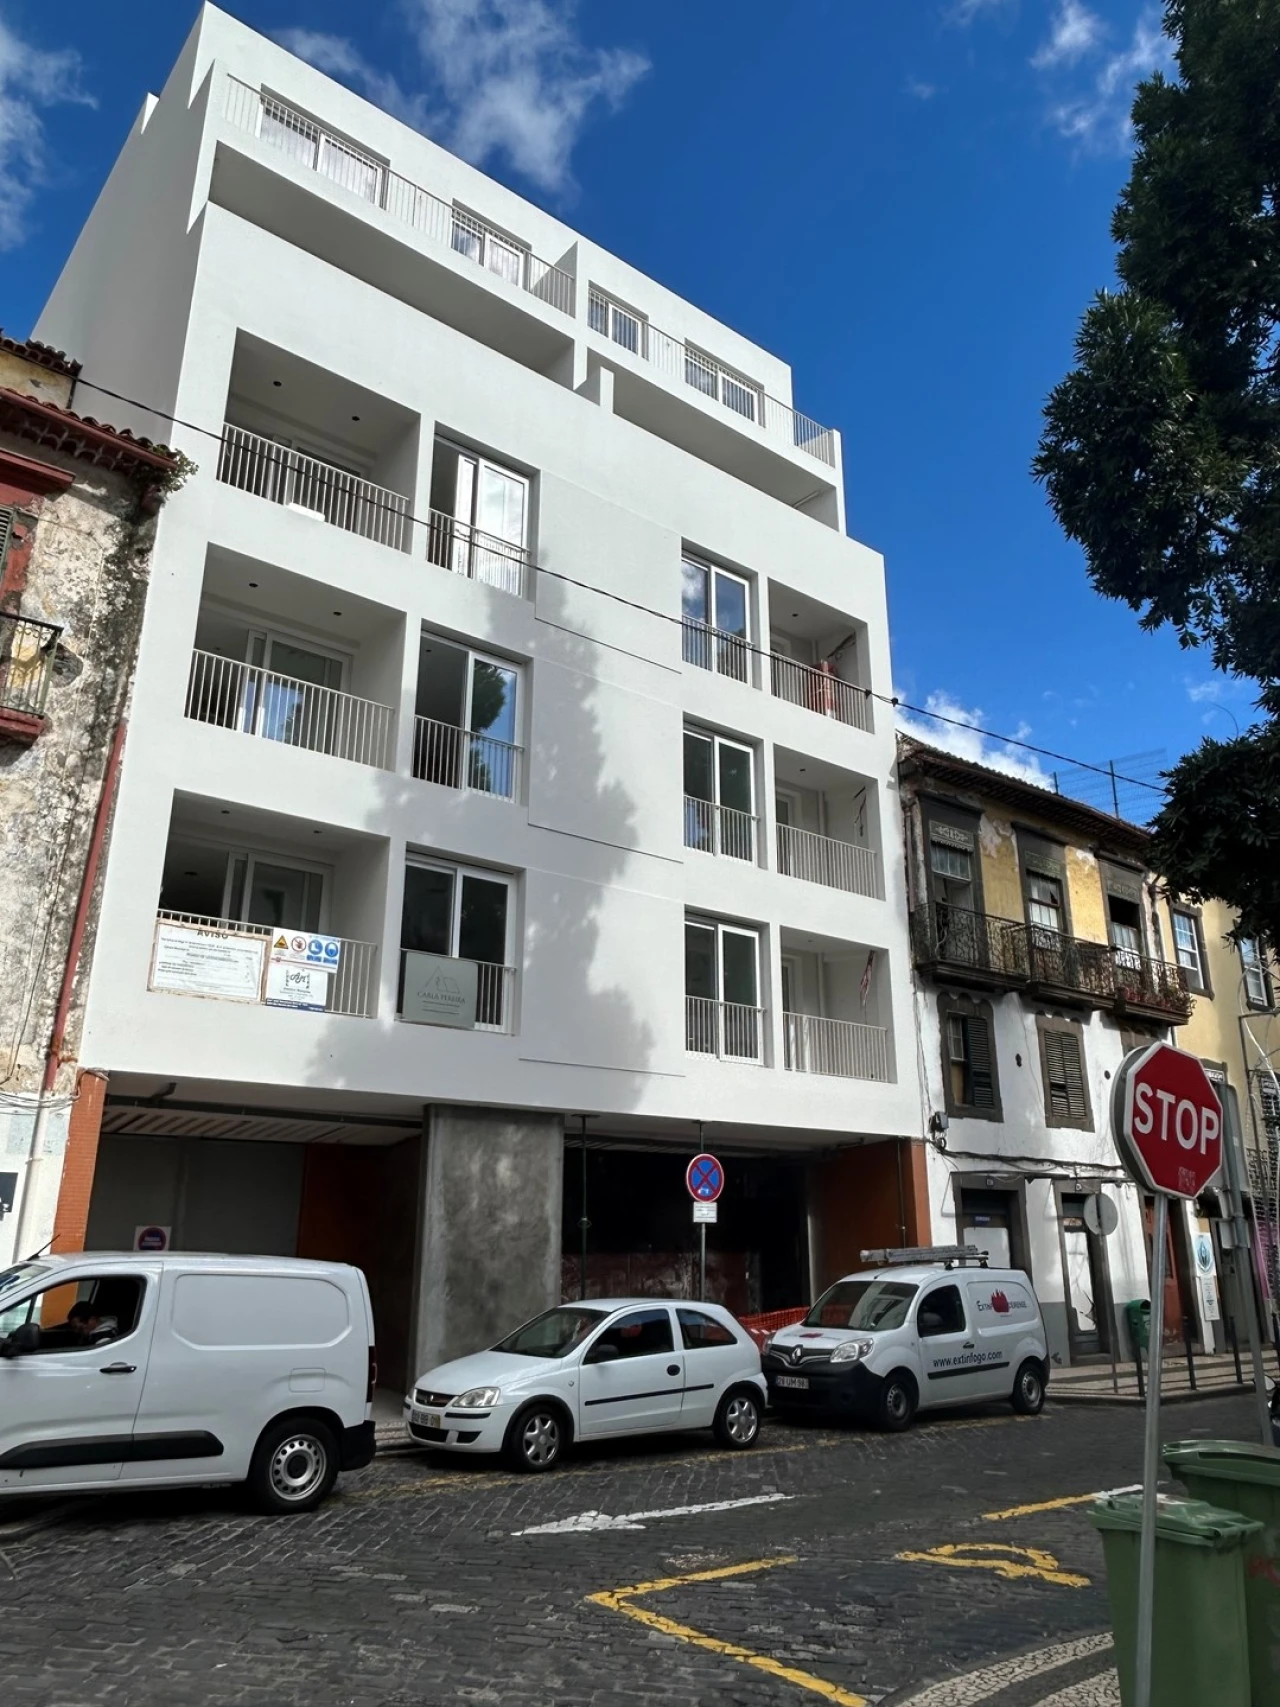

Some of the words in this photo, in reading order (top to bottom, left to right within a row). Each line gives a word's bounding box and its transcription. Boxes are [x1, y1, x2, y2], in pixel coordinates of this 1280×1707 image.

[197, 929, 228, 940] AVISO
[1133, 1082, 1220, 1155] STOP
[933, 1351, 1002, 1368] www.extinfogo.com
